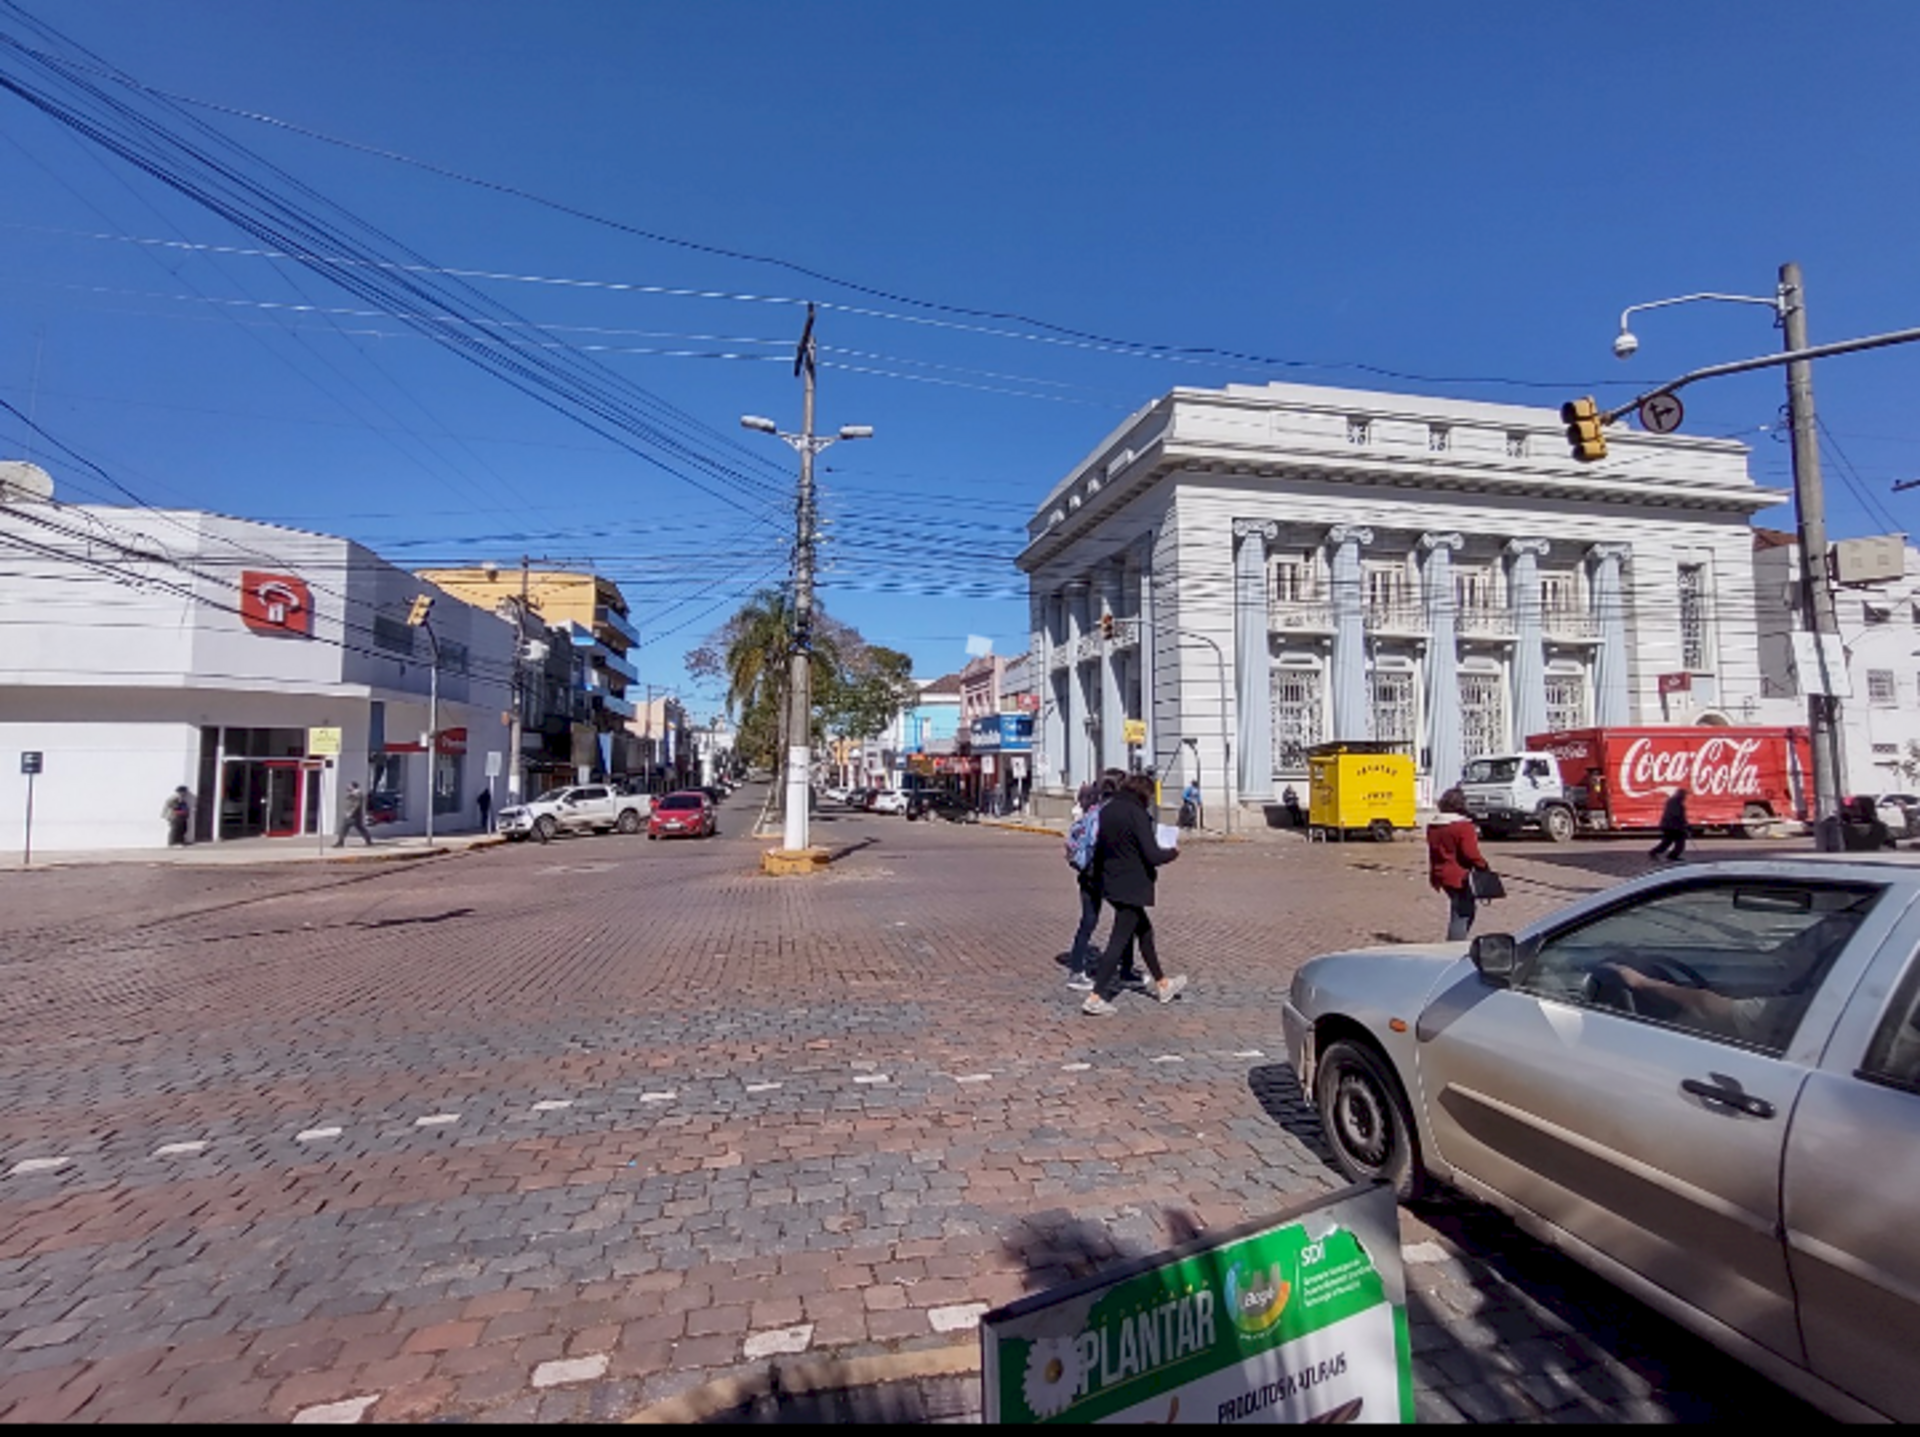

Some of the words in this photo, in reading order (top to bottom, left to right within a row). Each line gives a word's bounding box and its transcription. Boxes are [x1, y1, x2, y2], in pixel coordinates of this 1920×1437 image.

[1620, 738, 1762, 798] Coca-Cola
[1076, 1290, 1216, 1395] PLANTAR
[1218, 1378, 1285, 1424] PRODUTOS
